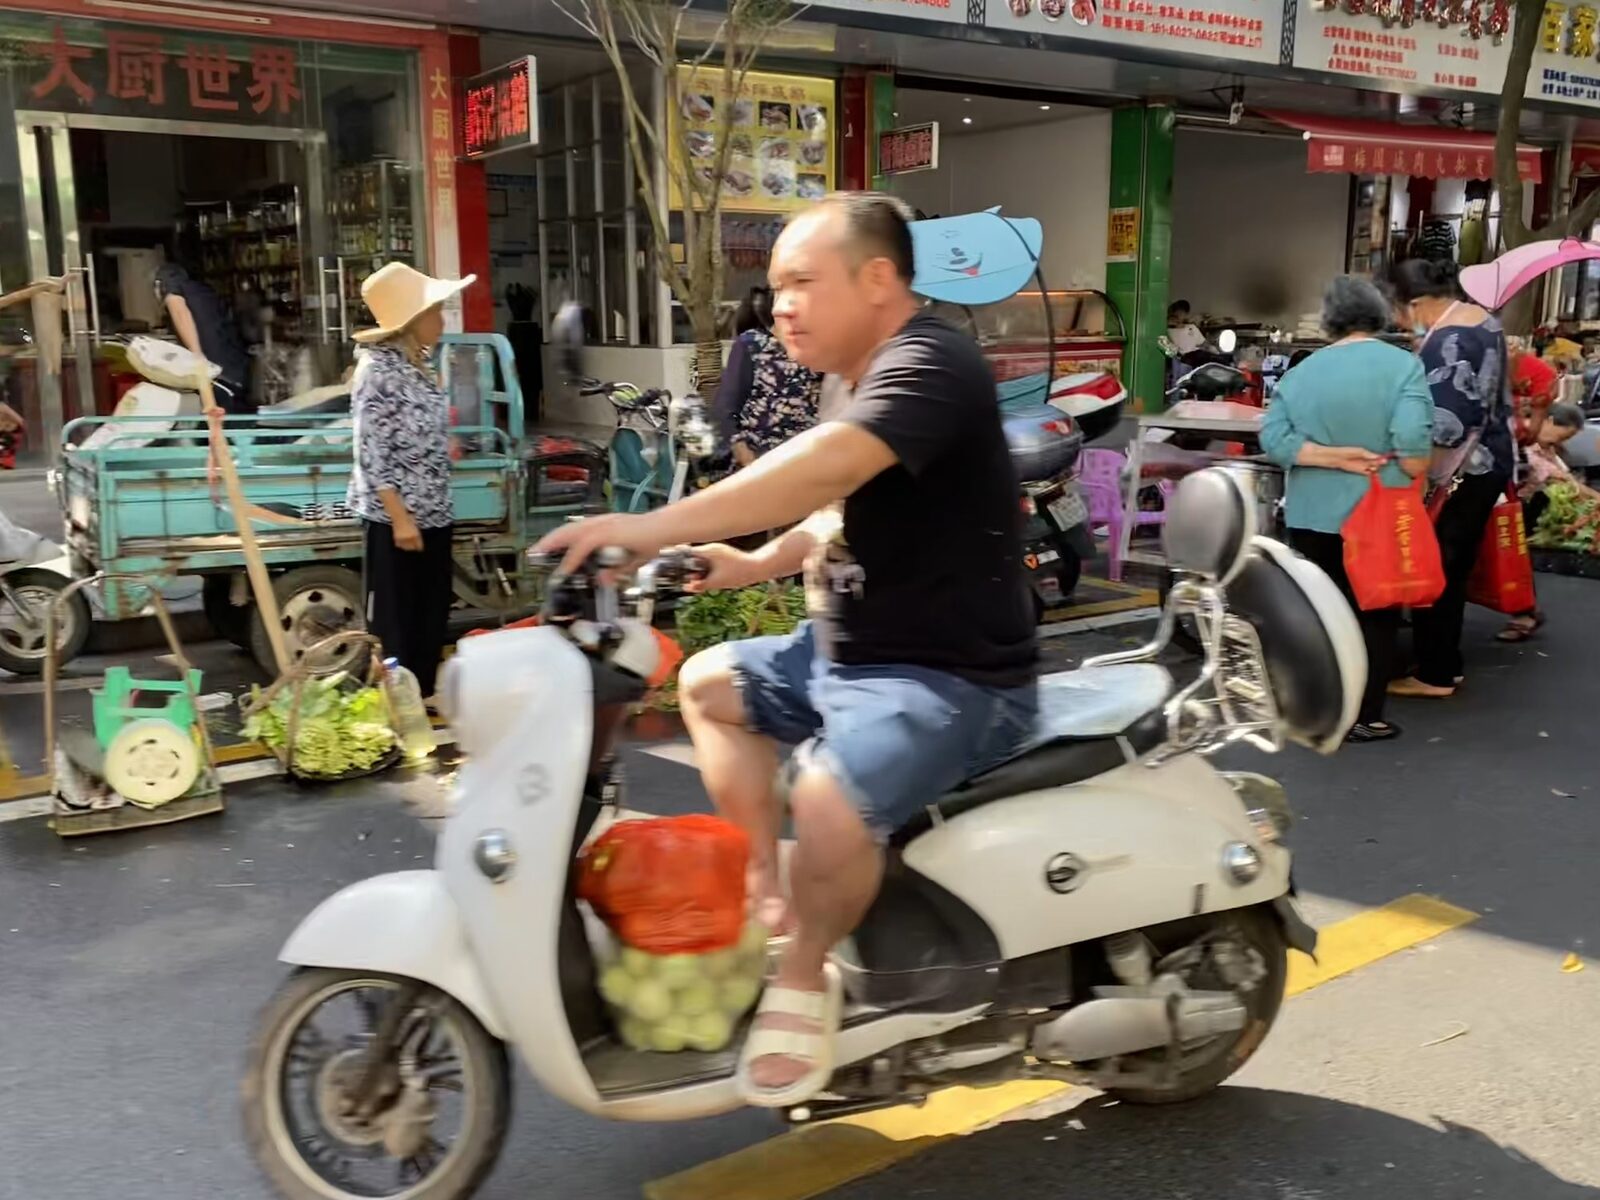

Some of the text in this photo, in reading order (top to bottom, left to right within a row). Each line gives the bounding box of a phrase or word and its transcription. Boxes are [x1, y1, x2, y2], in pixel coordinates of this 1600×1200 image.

[31, 19, 301, 114] 大厨世界
[430, 67, 453, 217] 大厨世界
